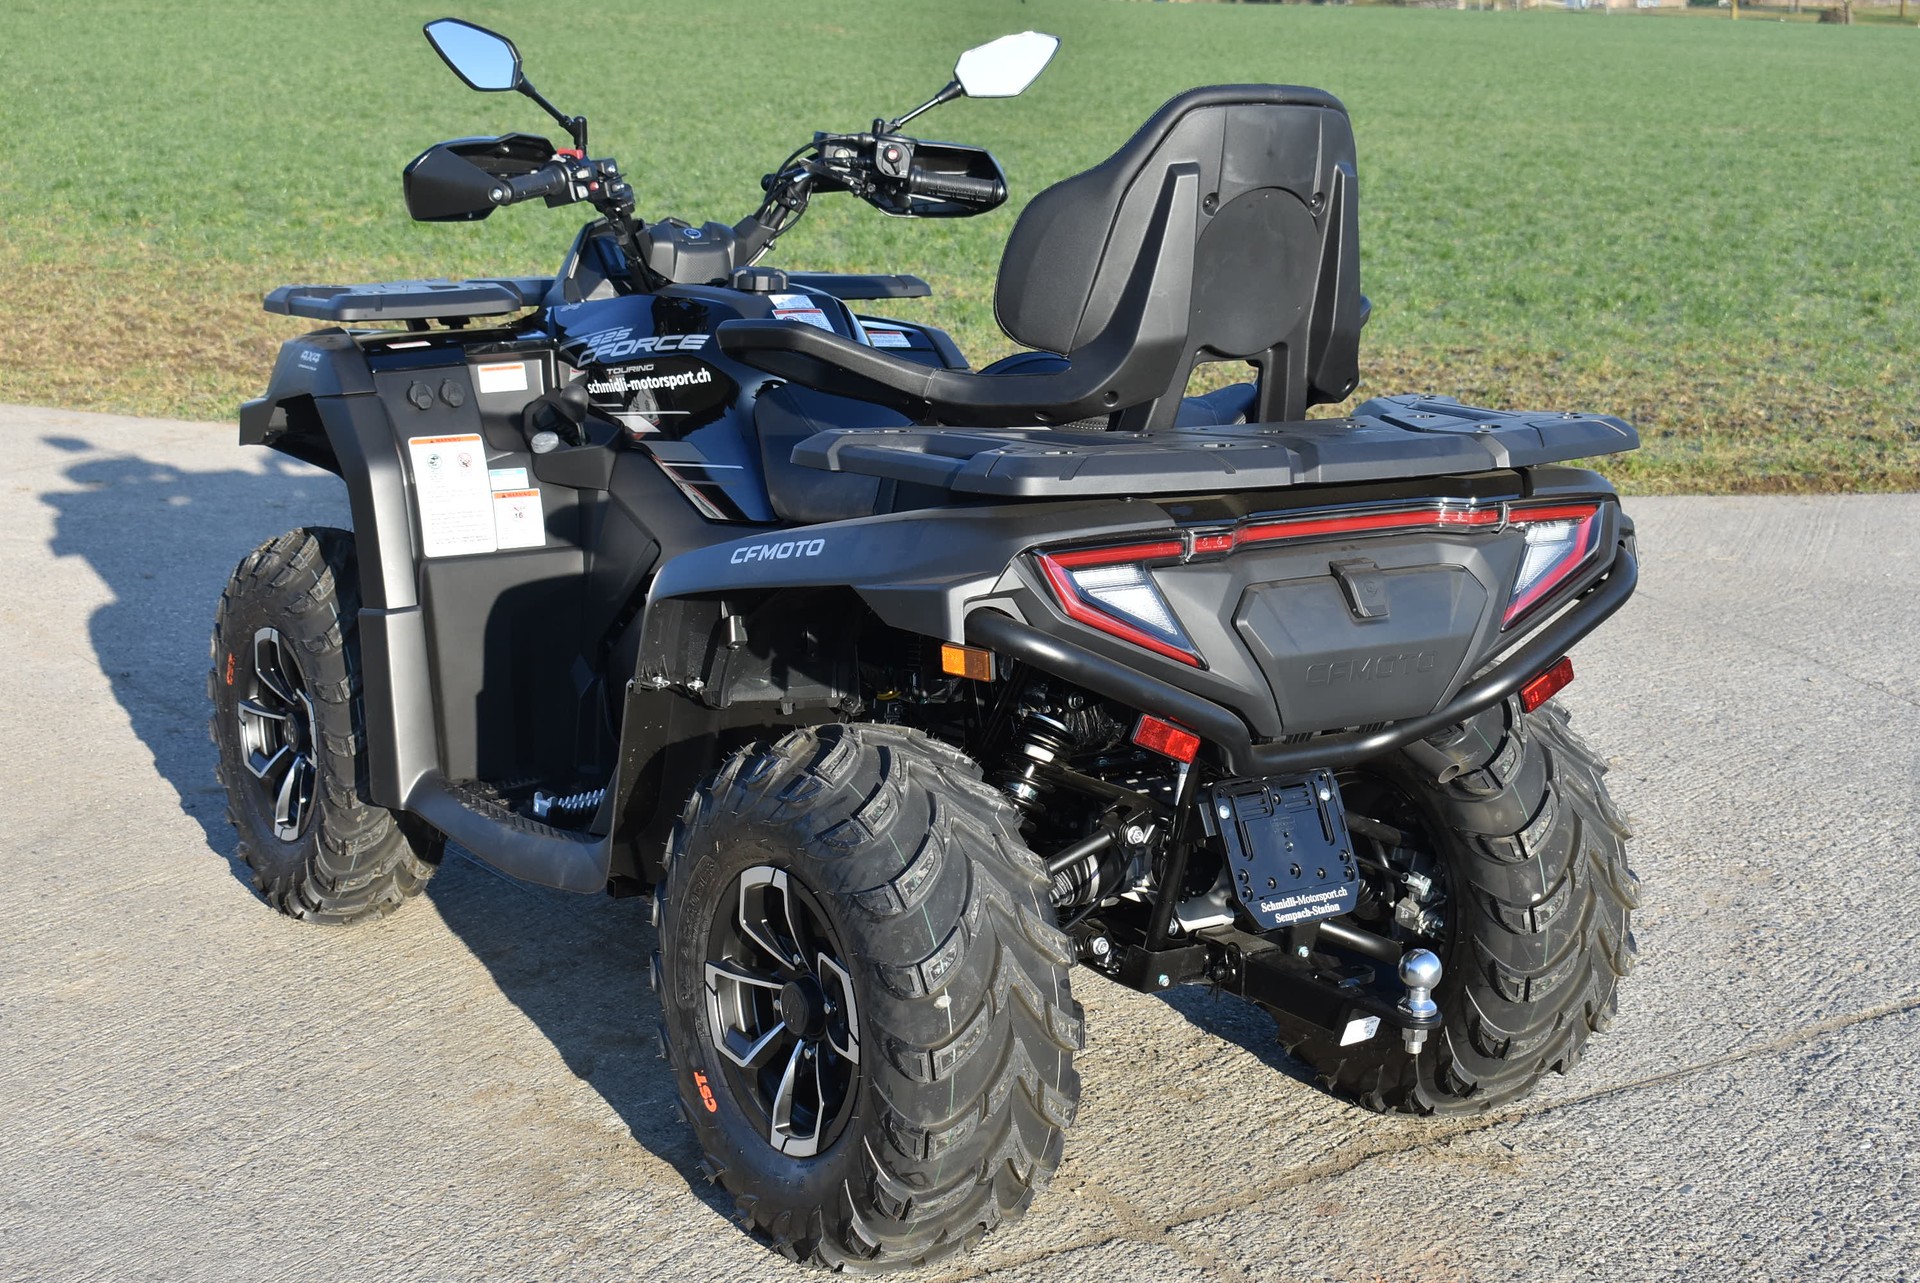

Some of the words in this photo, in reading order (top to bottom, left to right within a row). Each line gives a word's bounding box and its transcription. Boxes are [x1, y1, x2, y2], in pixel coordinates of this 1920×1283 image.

[577, 334, 711, 368] CFORCE
[587, 367, 712, 394] schmidli-motorsport.ch
[606, 363, 655, 375] TOURING
[435, 436, 462, 444] WARNING
[507, 491, 532, 499] WARNING
[730, 538, 826, 564] CFMOTO
[1305, 649, 1438, 687] CFMOTO
[1261, 886, 1348, 913] Schmidli-Motorsport.ch
[1275, 902, 1341, 924] Sempach-Station
[693, 1071, 718, 1113] CST
